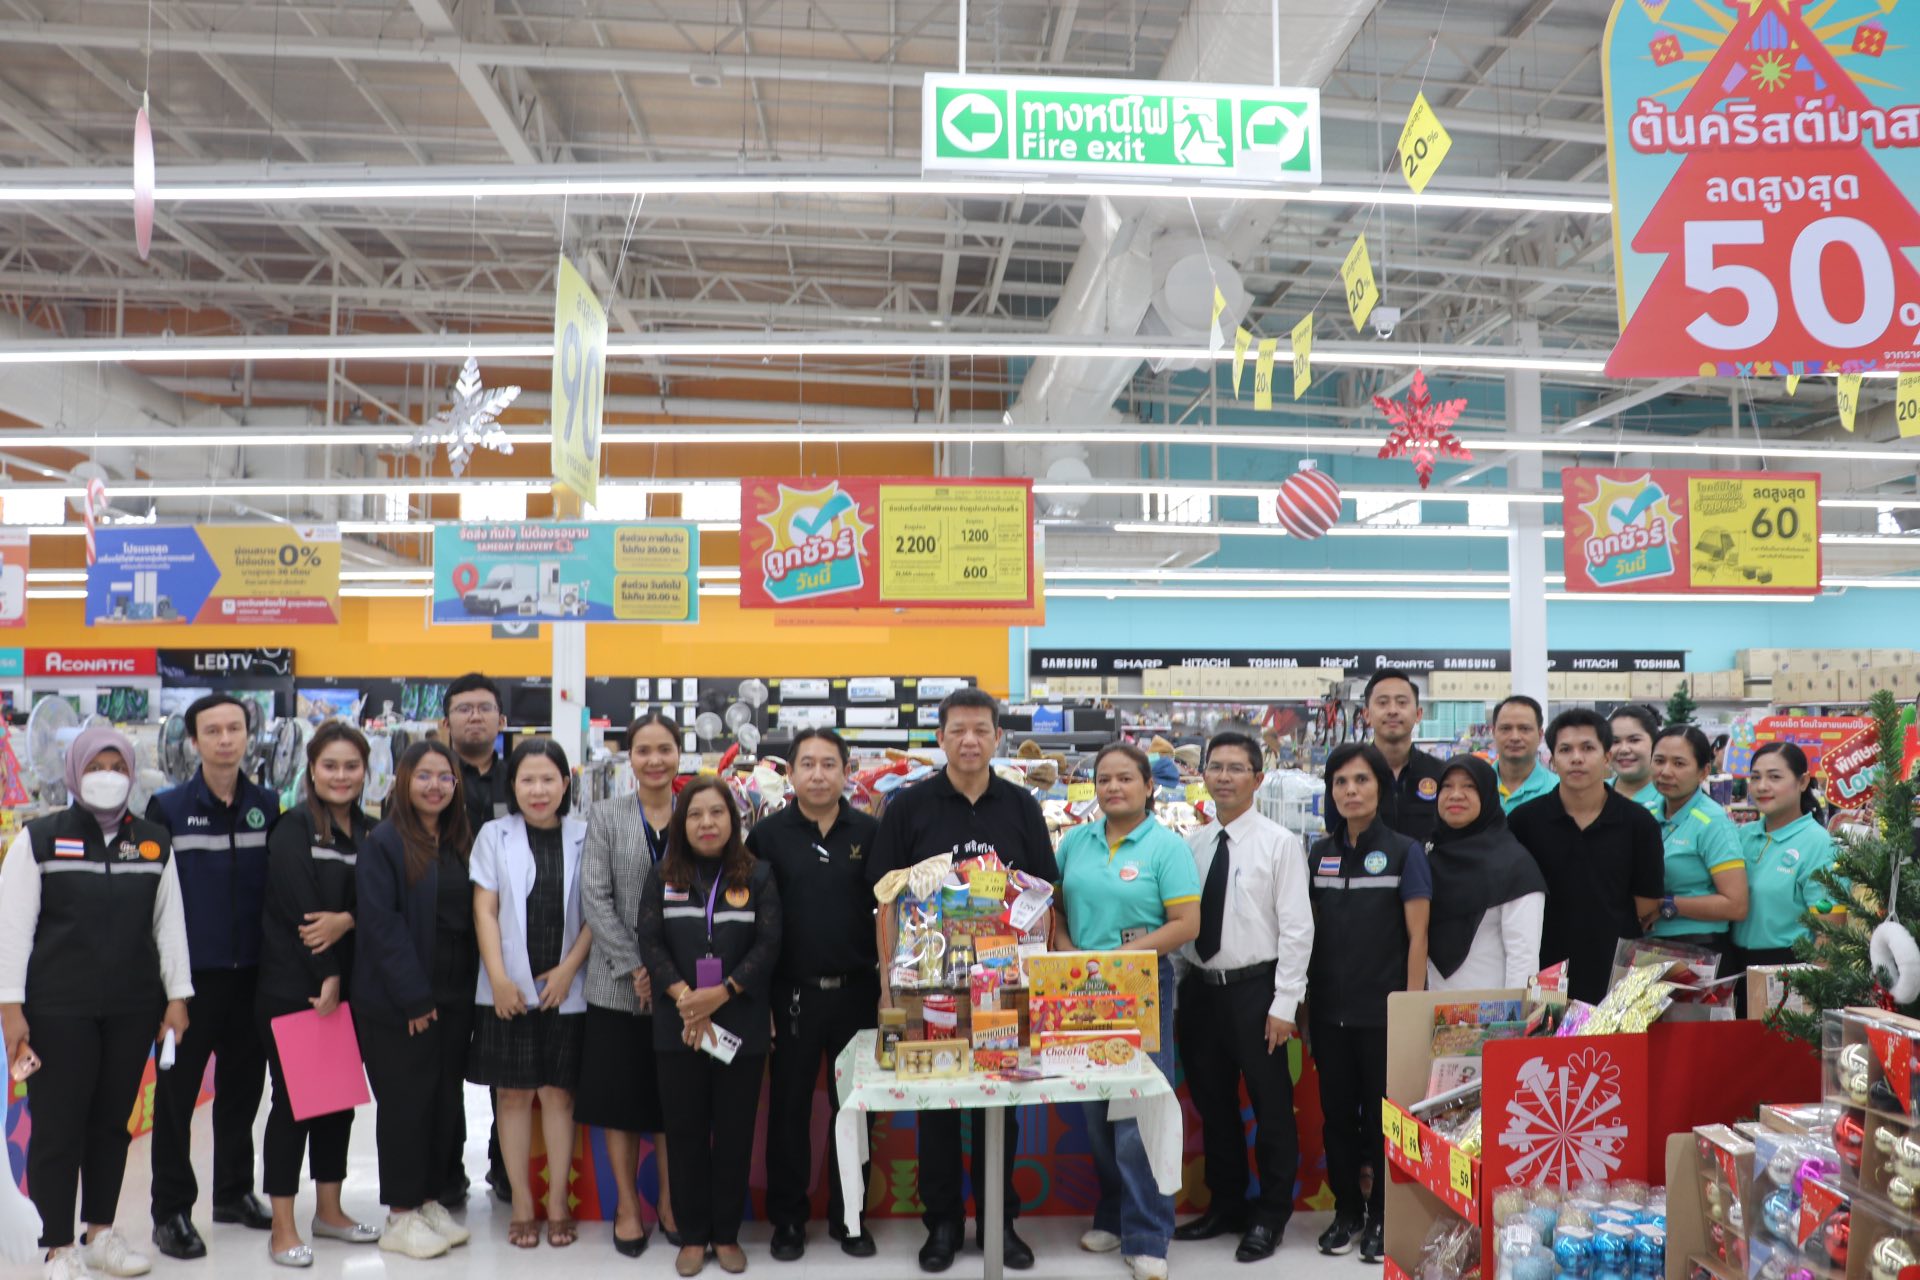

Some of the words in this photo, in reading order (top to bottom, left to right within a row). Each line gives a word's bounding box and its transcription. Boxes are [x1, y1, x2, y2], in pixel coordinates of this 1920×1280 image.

[1022, 95, 1168, 135] ทางหนีไฟ
[1022, 132, 1078, 160] Fire
[1087, 135, 1146, 162] exit
[1706, 174, 1859, 213] ลดสูงสุด
[561, 320, 600, 462] 90
[1753, 487, 1806, 503] ลดสูงสุด
[515, 541, 554, 552] DELIVERY
[896, 536, 936, 554] 2,200
[1588, 519, 1666, 565] ถูกชัวร์
[278, 543, 322, 567] 0%
[768, 528, 853, 579] ถูกชัวร์
[1615, 550, 1647, 577] วันนี้
[796, 564, 832, 591] วันนี้
[963, 566, 988, 579] 600
[45, 652, 136, 672] ACONATIC
[1041, 657, 1098, 669] SAMSUNG
[1113, 658, 1163, 669] SHARP
[1182, 657, 1231, 668] HITACHI
[1248, 657, 1298, 668] TOSHIBA
[1319, 655, 1359, 668] Hatari
[1443, 658, 1496, 669] SAMSUNG
[1573, 658, 1619, 669] HITACHI
[1633, 659, 1680, 669] TOSHIBA
[987, 1026, 1017, 1039] HOUTEN
[1391, 1122, 1400, 1137] 99
[1409, 1137, 1417, 1153] 99
[1460, 1170, 1469, 1188] 59
